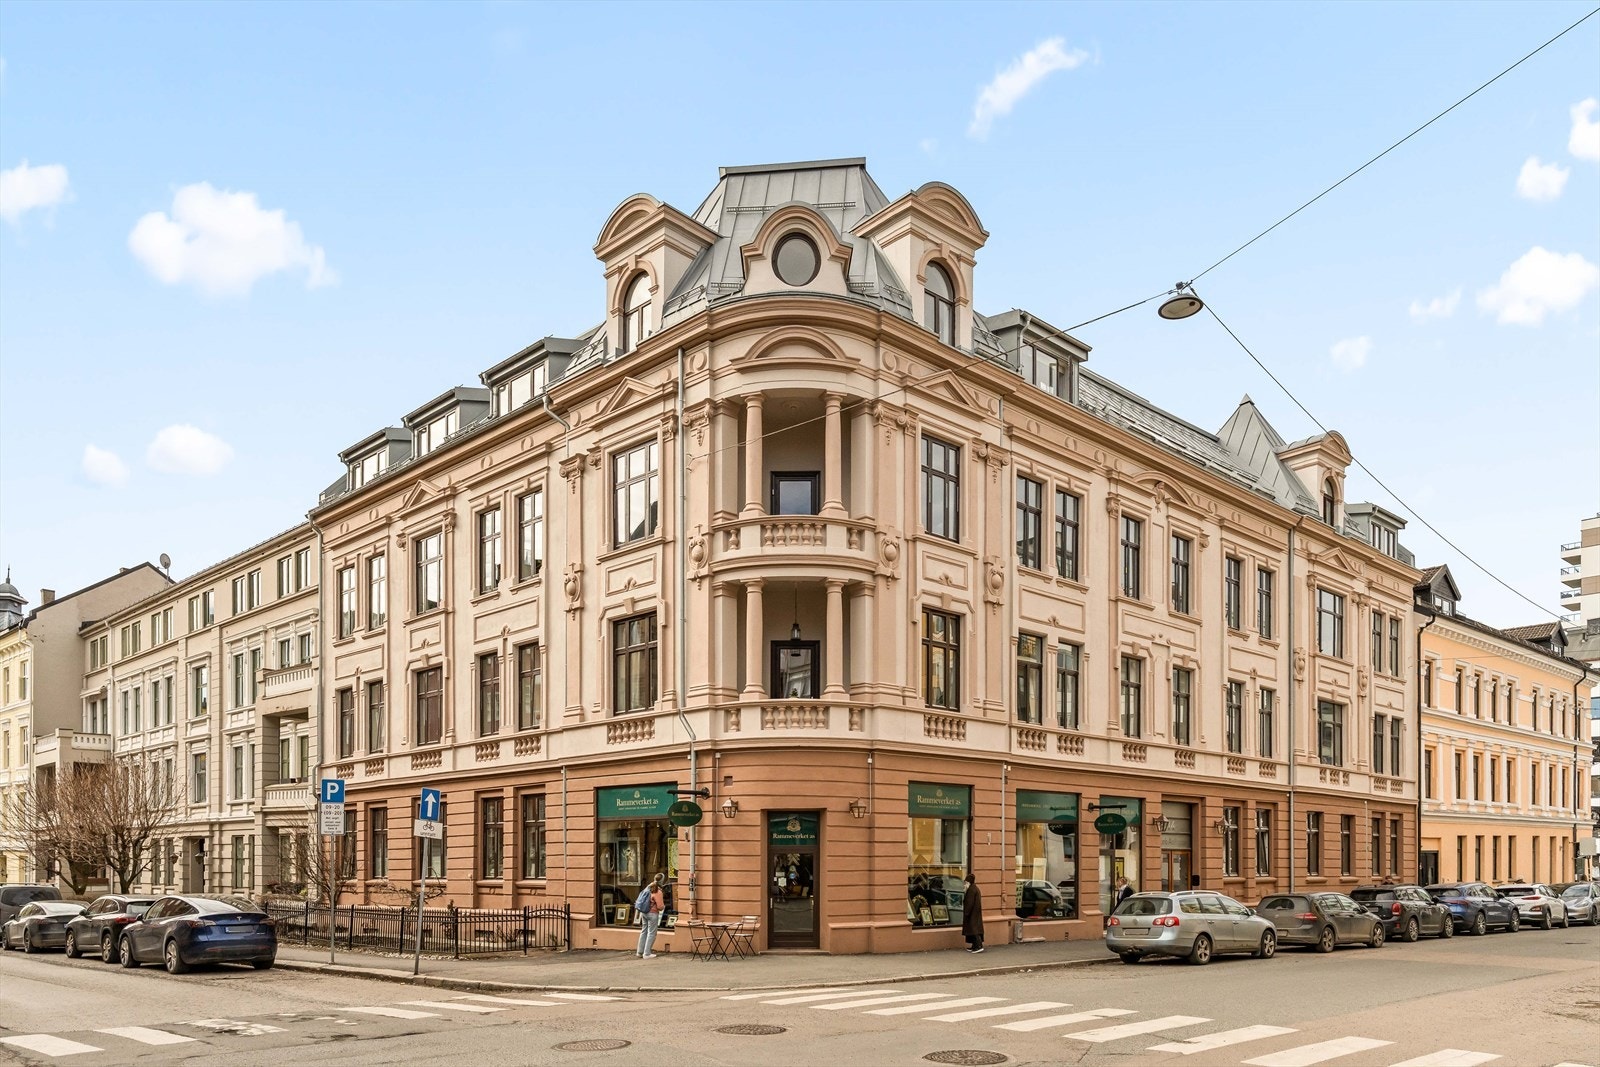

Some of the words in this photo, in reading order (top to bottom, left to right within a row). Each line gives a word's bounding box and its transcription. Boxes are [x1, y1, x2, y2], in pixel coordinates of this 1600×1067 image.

[327, 782, 340, 801] P
[616, 797, 652, 806] Rammeverket
[917, 795, 954, 805] Rammeverket
